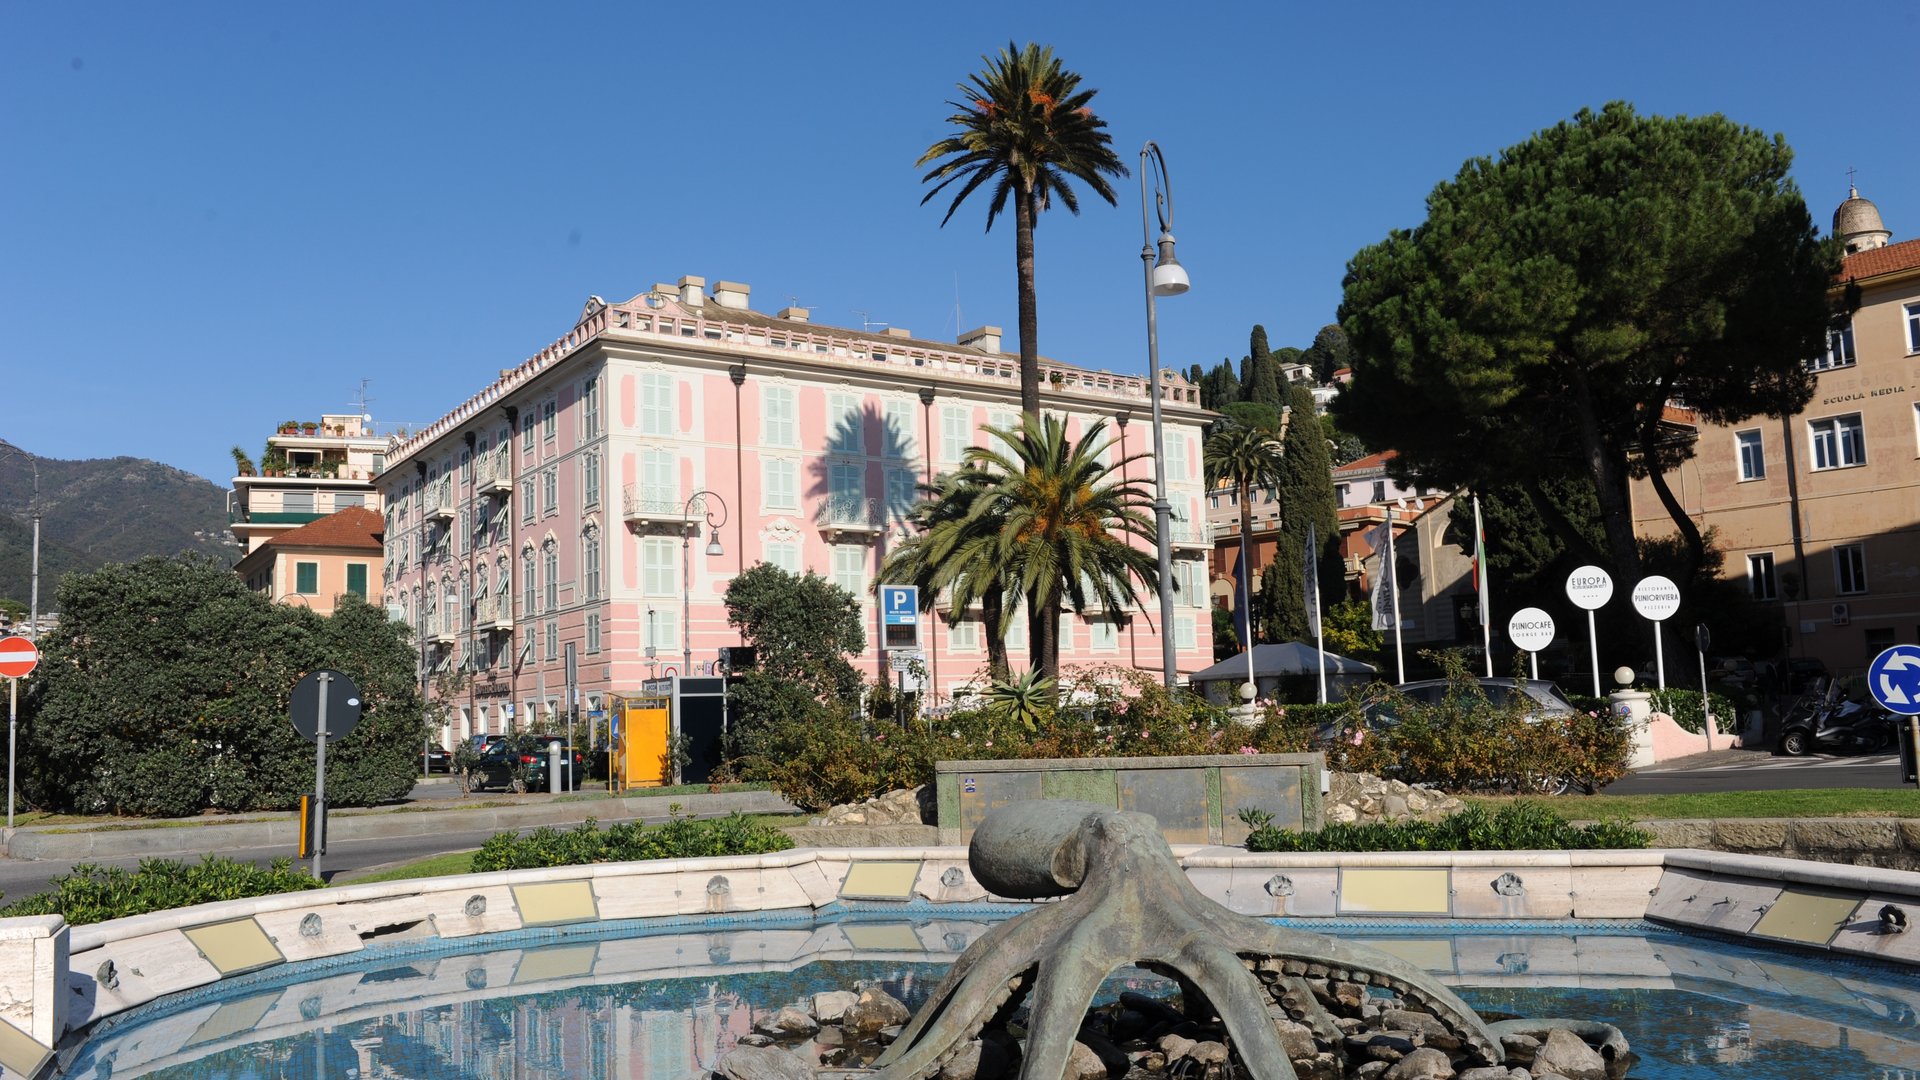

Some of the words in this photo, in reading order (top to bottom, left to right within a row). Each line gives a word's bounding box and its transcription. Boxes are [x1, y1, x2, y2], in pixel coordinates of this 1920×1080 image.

[1823, 393, 1865, 405] SCUOLA
[1572, 576, 1606, 586] EUROPA
[894, 591, 906, 610] P
[1634, 594, 1678, 602] PLINIORIVIERA
[1511, 621, 1552, 630] PLINIOCAFE
